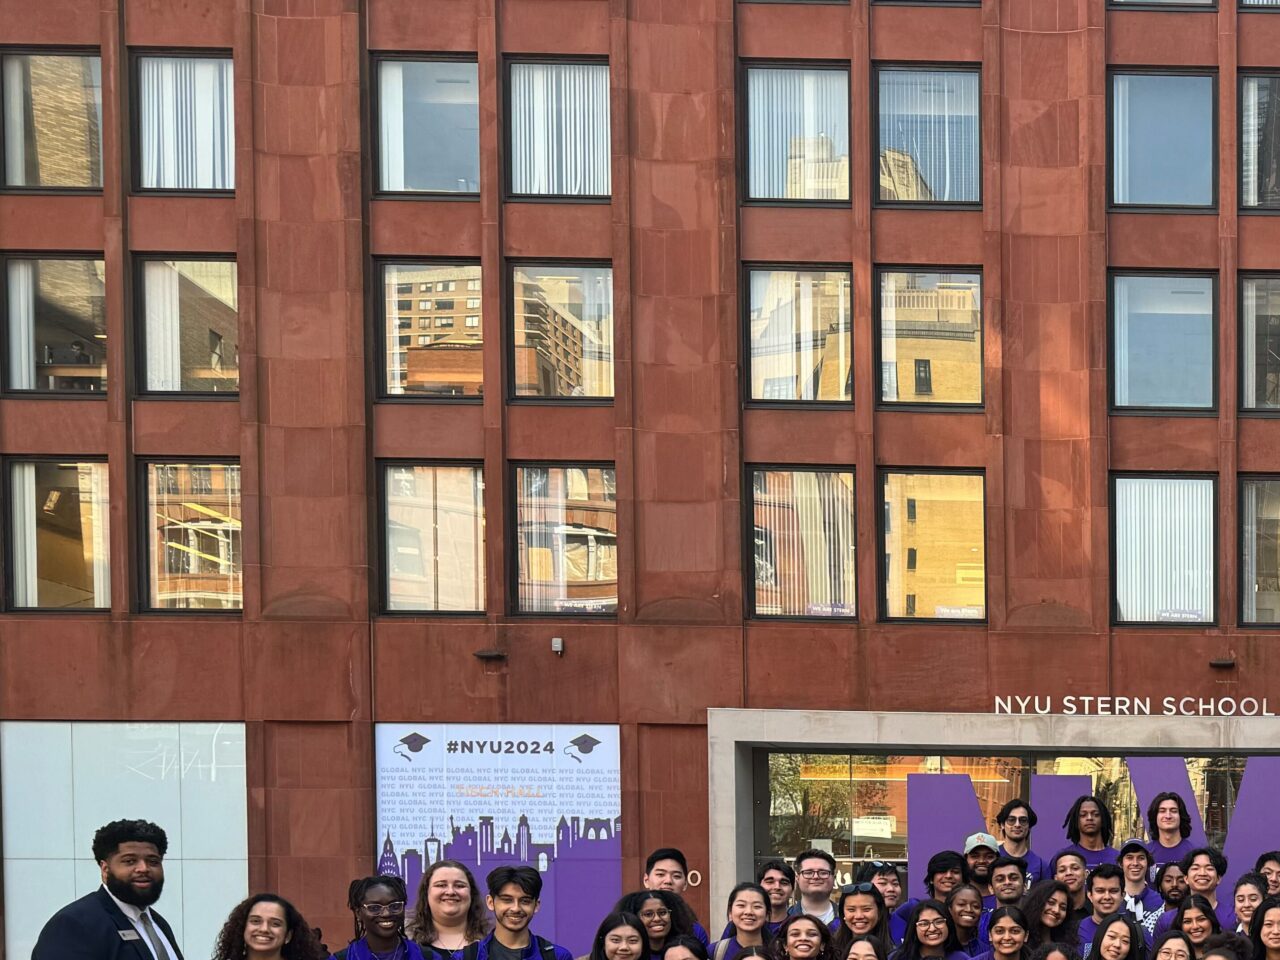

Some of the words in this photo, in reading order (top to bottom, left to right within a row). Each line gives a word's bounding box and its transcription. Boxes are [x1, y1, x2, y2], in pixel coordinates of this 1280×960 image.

[994, 695, 1051, 715] NYU
[1062, 695, 1150, 715] STERN
[1162, 696, 1275, 716] SCHOOL
[446, 740, 555, 754] #NYU2024
